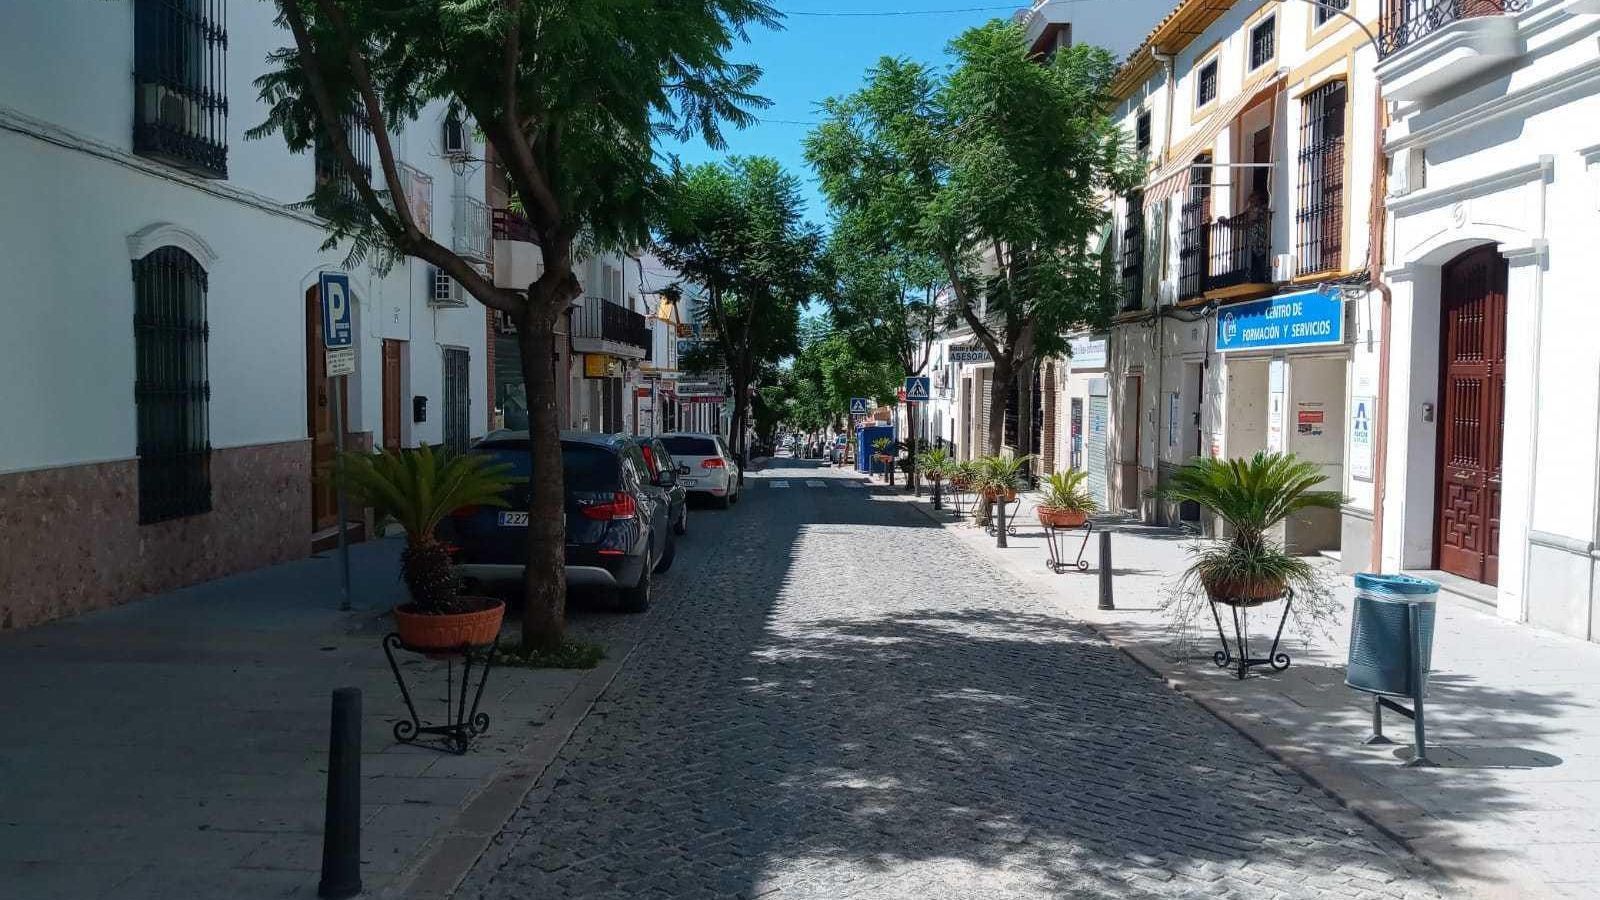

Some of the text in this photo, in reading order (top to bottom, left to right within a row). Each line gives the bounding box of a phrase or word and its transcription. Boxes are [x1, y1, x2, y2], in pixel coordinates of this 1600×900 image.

[327, 282, 345, 338] P
[1265, 302, 1303, 319] CENTRO DE
[1242, 323, 1280, 341] FORMACIÓN
[1283, 324, 1289, 339] Y
[1291, 320, 1331, 337] SERVICIOS
